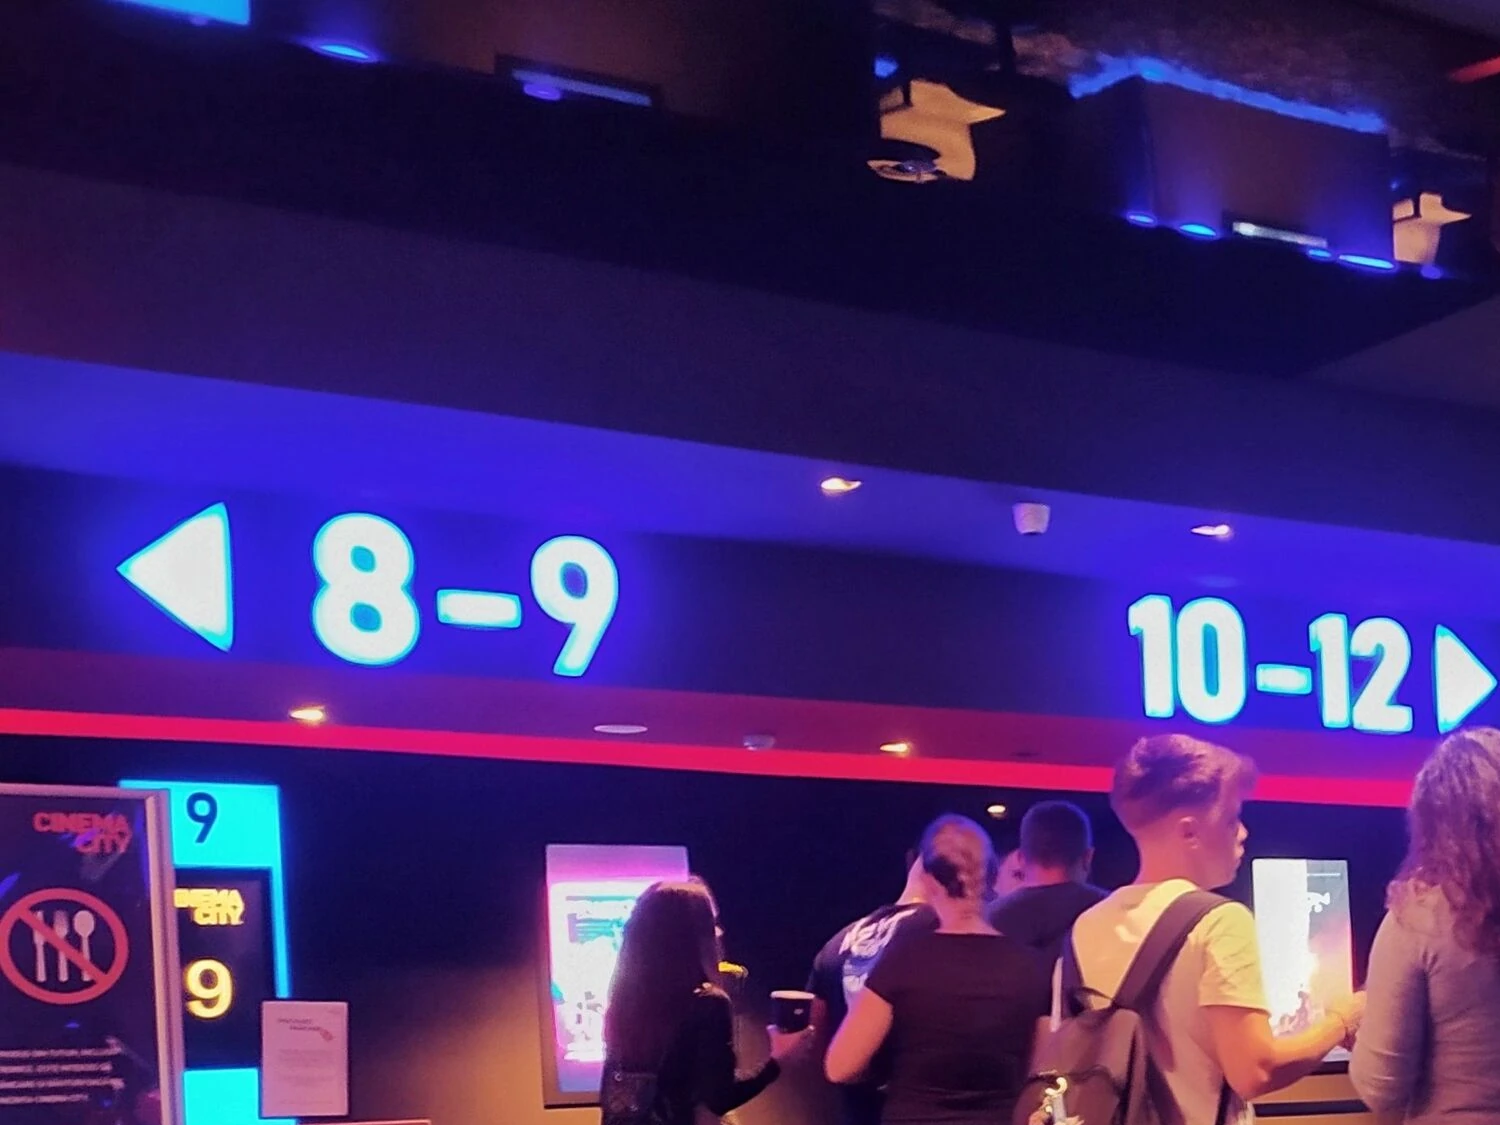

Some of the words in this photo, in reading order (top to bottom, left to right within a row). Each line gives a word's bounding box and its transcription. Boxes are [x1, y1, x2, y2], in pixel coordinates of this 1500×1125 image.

[311, 511, 618, 678] 8-9
[1127, 594, 1413, 733] 10-12
[186, 792, 218, 844] 9
[185, 958, 233, 1020] 9
